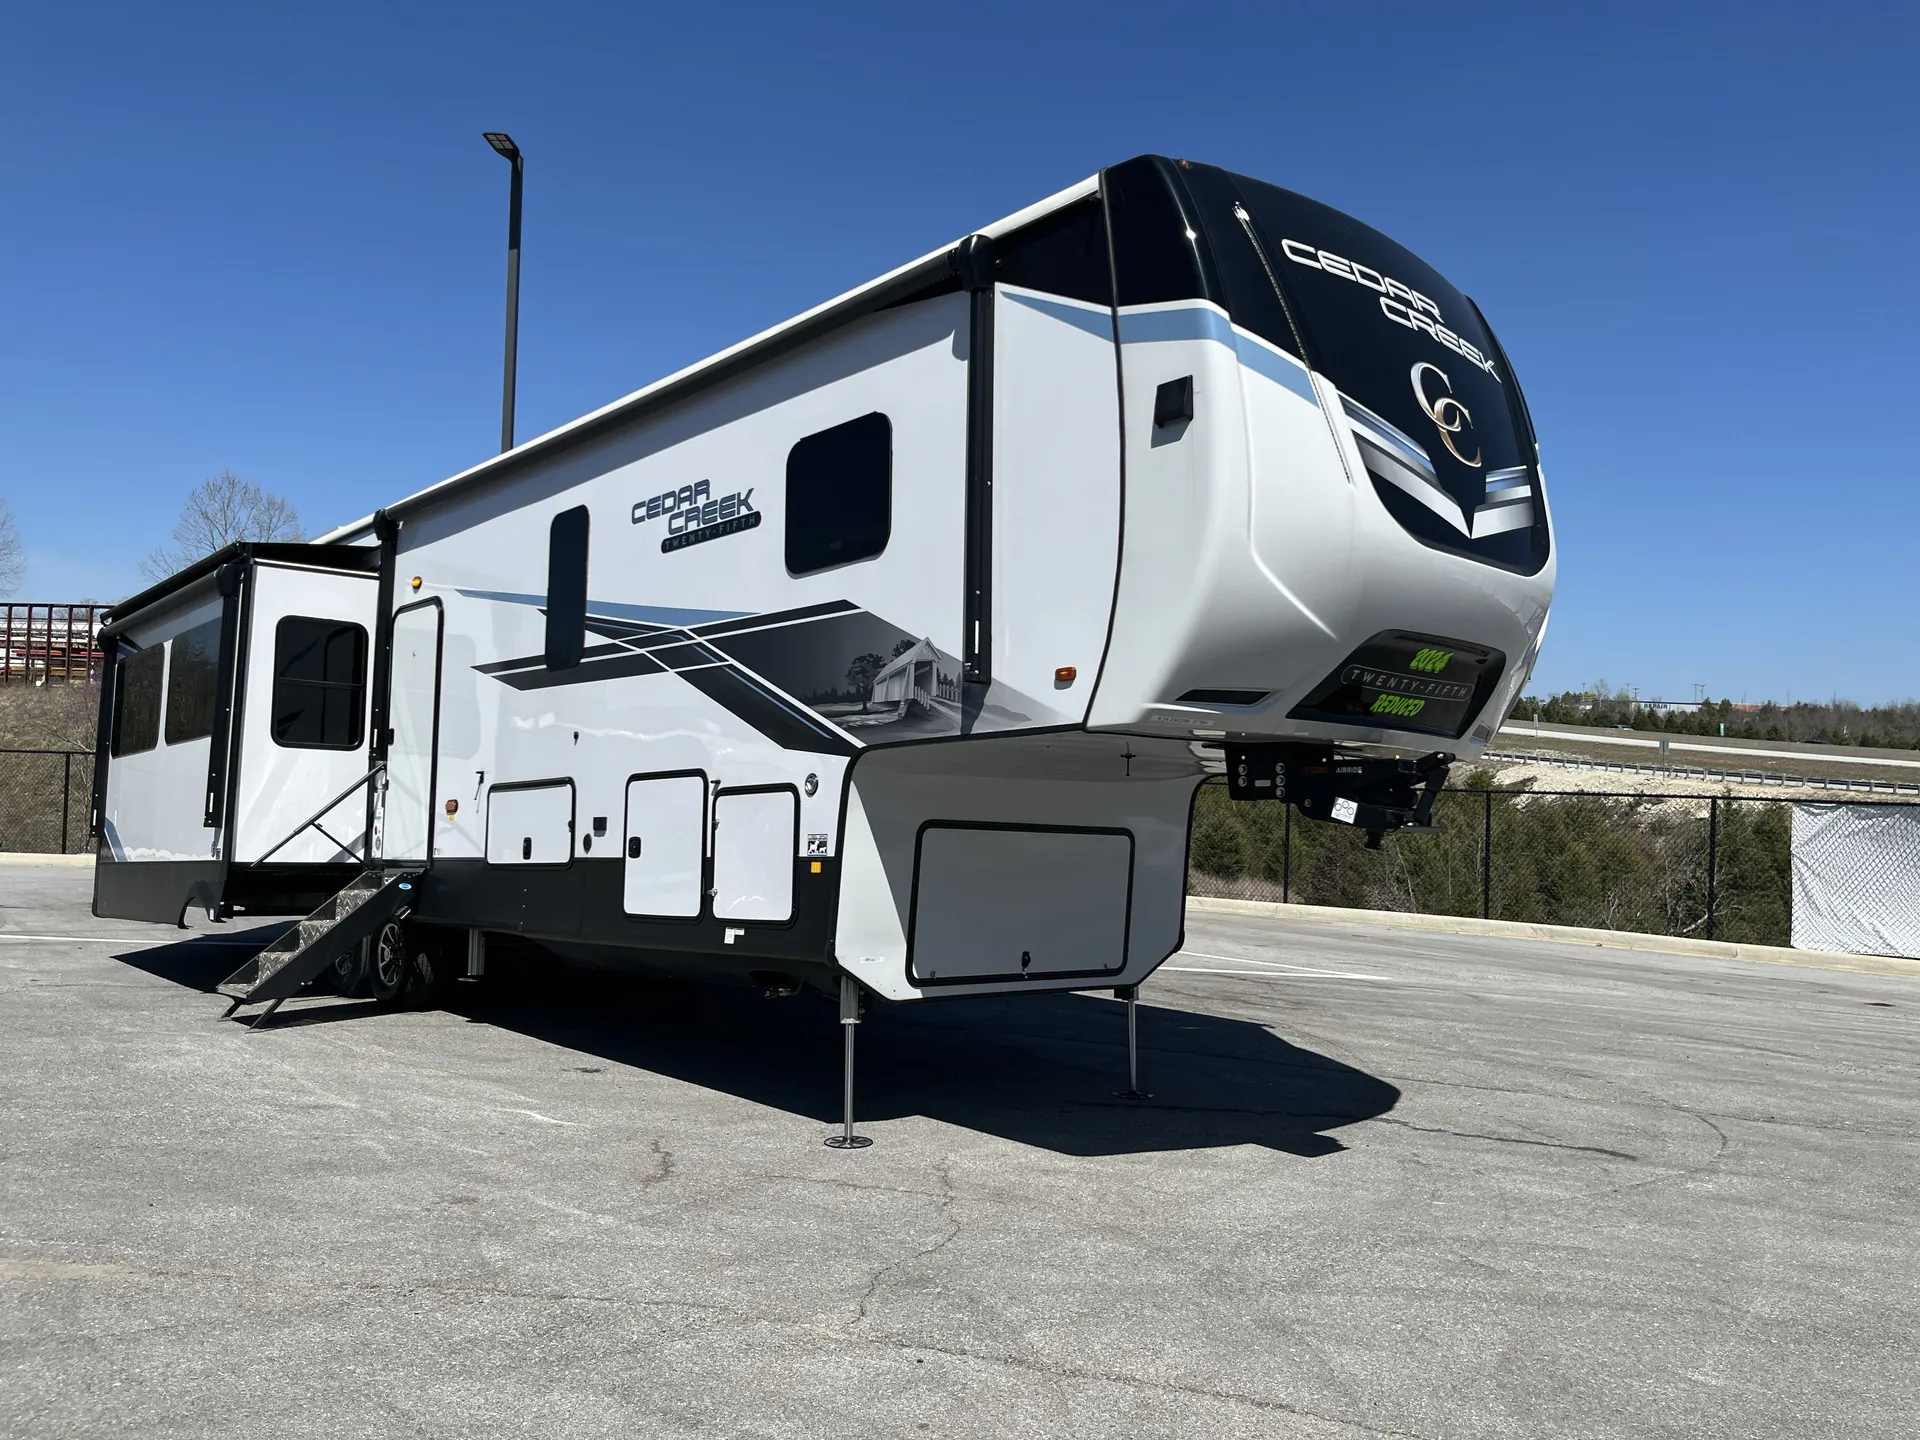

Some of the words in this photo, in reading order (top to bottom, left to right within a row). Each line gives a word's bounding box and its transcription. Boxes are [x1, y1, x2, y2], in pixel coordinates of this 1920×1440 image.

[1281, 238, 1445, 324] CEDAR
[1379, 296, 1502, 384] CREEK
[631, 478, 711, 525] CEDAR
[668, 487, 755, 536] CREEK
[664, 514, 756, 551] TWENTY-FIFTH
[1409, 648, 1454, 674] 2024
[1351, 669, 1468, 697] TWENTY-FIFTH
[1369, 693, 1426, 717] REDUCED
